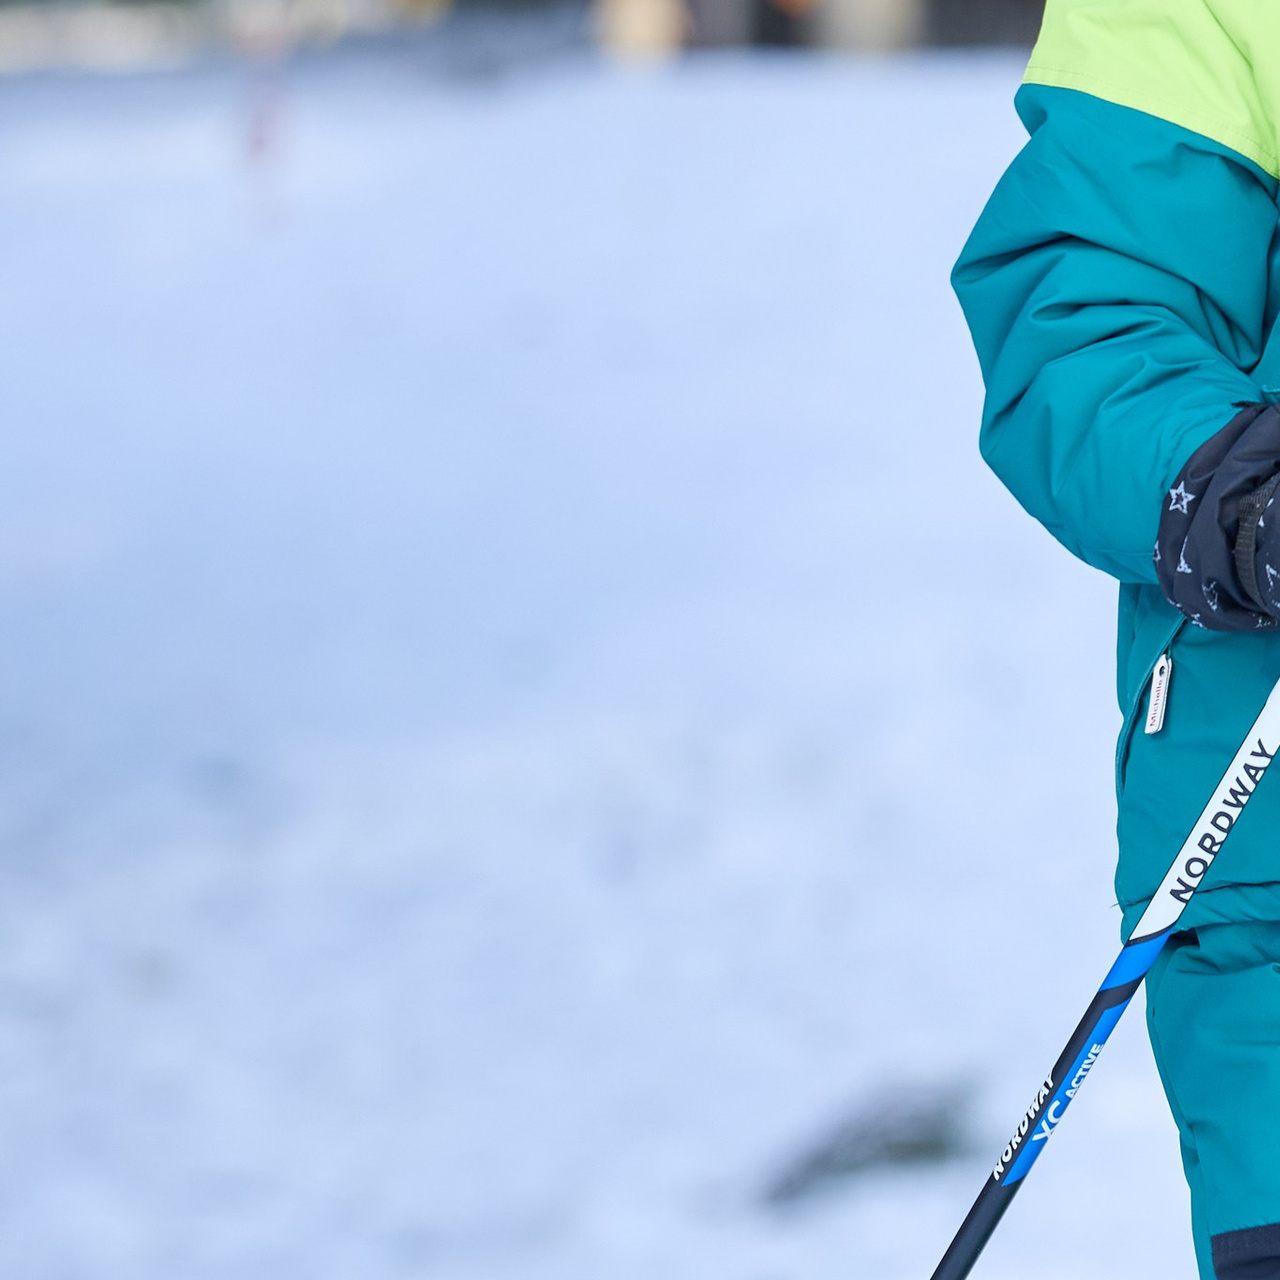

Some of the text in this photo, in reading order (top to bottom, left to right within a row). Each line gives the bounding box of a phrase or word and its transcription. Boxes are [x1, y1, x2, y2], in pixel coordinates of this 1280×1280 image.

[1169, 738, 1275, 904] NORDWAY
[1031, 1043, 1104, 1141] XC ACTIVE
